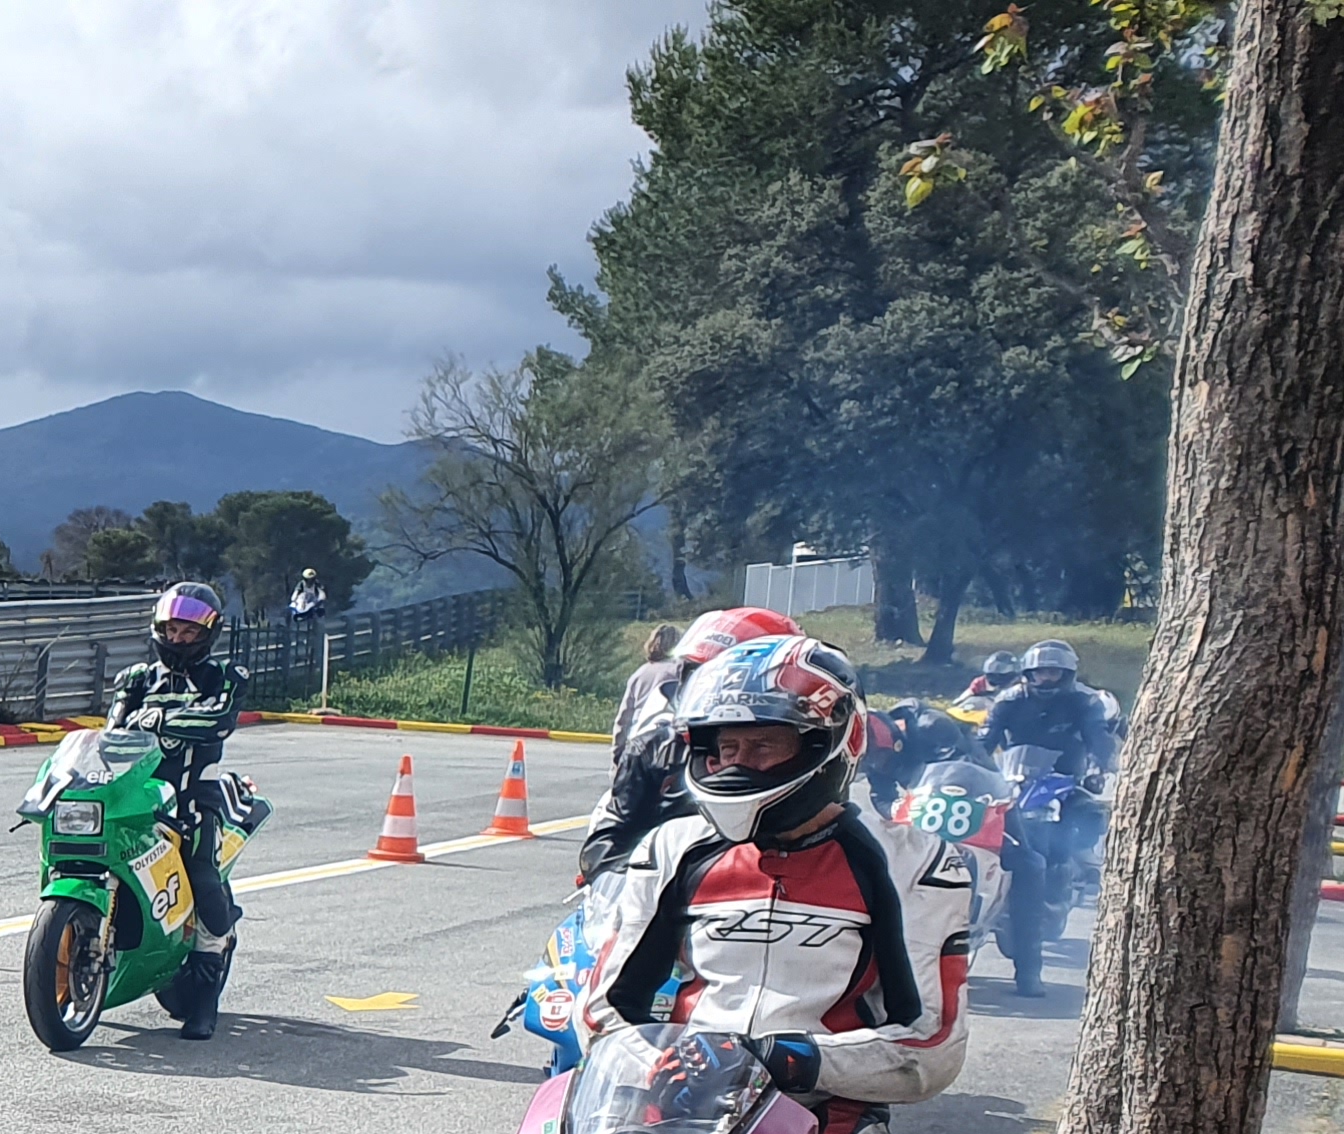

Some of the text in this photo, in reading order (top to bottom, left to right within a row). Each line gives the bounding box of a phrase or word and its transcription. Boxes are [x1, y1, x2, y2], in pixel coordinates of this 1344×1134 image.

[705, 691, 769, 705] SHARK
[921, 797, 972, 837] 88
[688, 909, 864, 948] RST
